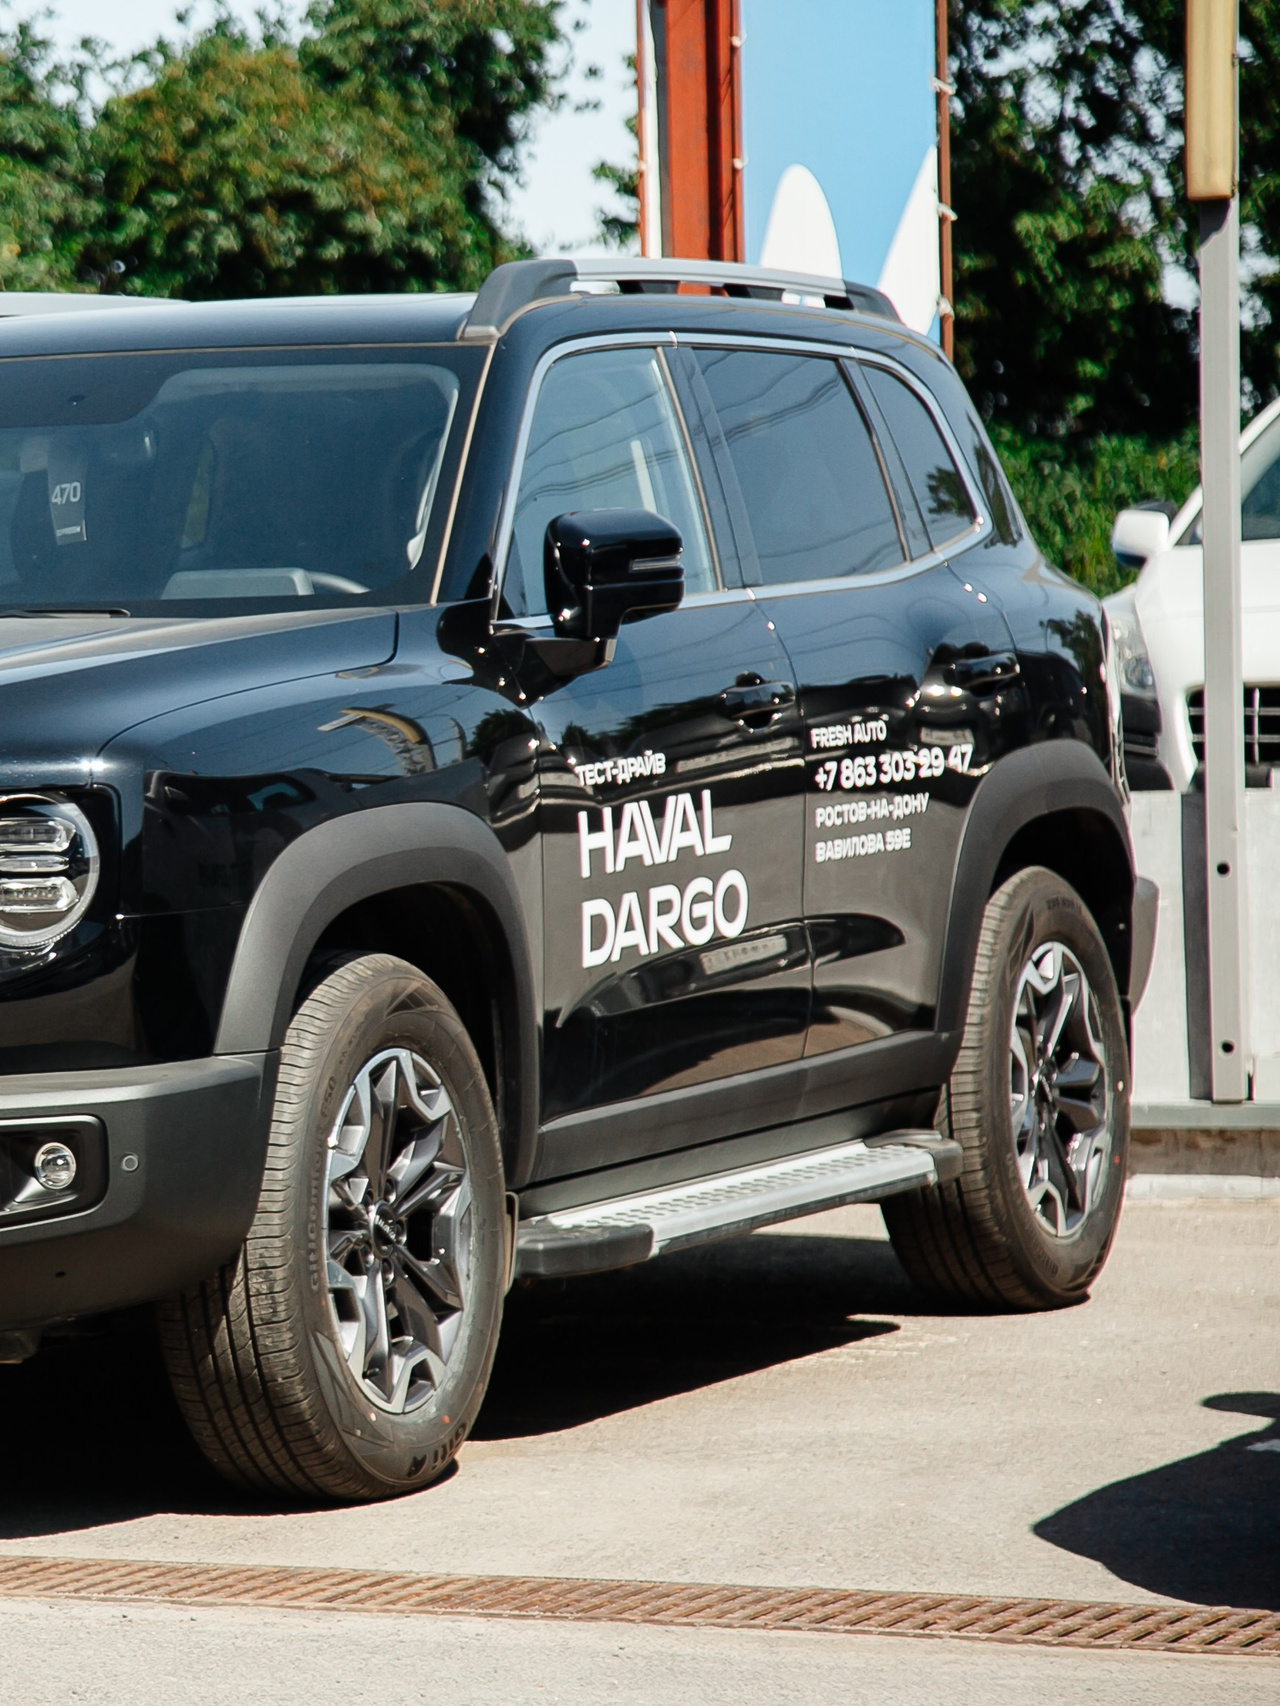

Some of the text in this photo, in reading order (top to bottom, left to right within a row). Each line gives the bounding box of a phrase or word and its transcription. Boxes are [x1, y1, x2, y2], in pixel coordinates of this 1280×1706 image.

[51, 481, 81, 505] 470
[810, 720, 887, 748] FRESH AUTO
[574, 749, 666, 786] ТЕСТ-ДРАЙВ
[815, 743, 974, 791] +7 863 303 29 47
[815, 792, 929, 828] РОСТОВ-НА-ДОНУ
[578, 789, 733, 879] HAVAL
[815, 832, 885, 863] ВАВИЛОВА
[582, 869, 749, 969] DARGO
